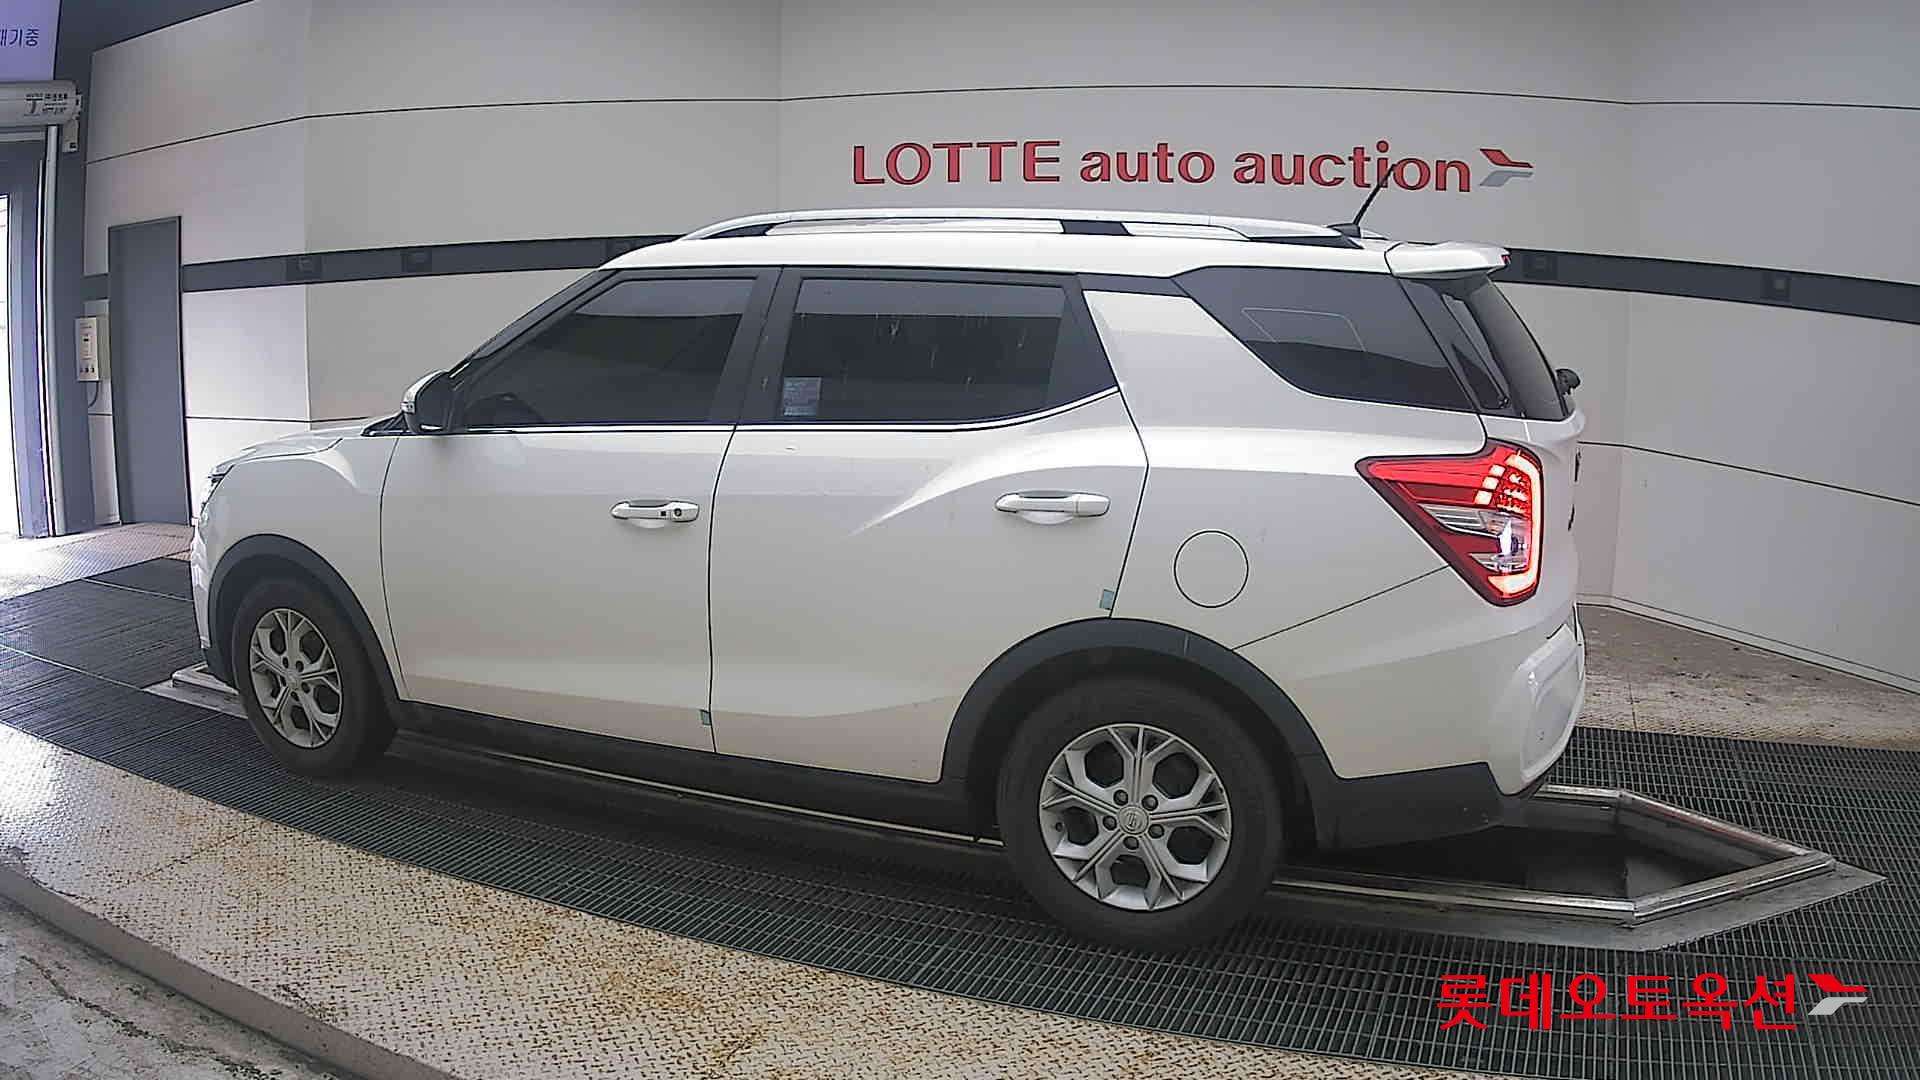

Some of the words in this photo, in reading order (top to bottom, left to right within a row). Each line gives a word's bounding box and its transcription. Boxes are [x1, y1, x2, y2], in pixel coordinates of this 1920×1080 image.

[852, 140, 1060, 185] LOTTE
[1080, 143, 1215, 184] auto
[1233, 140, 1472, 192] auction
